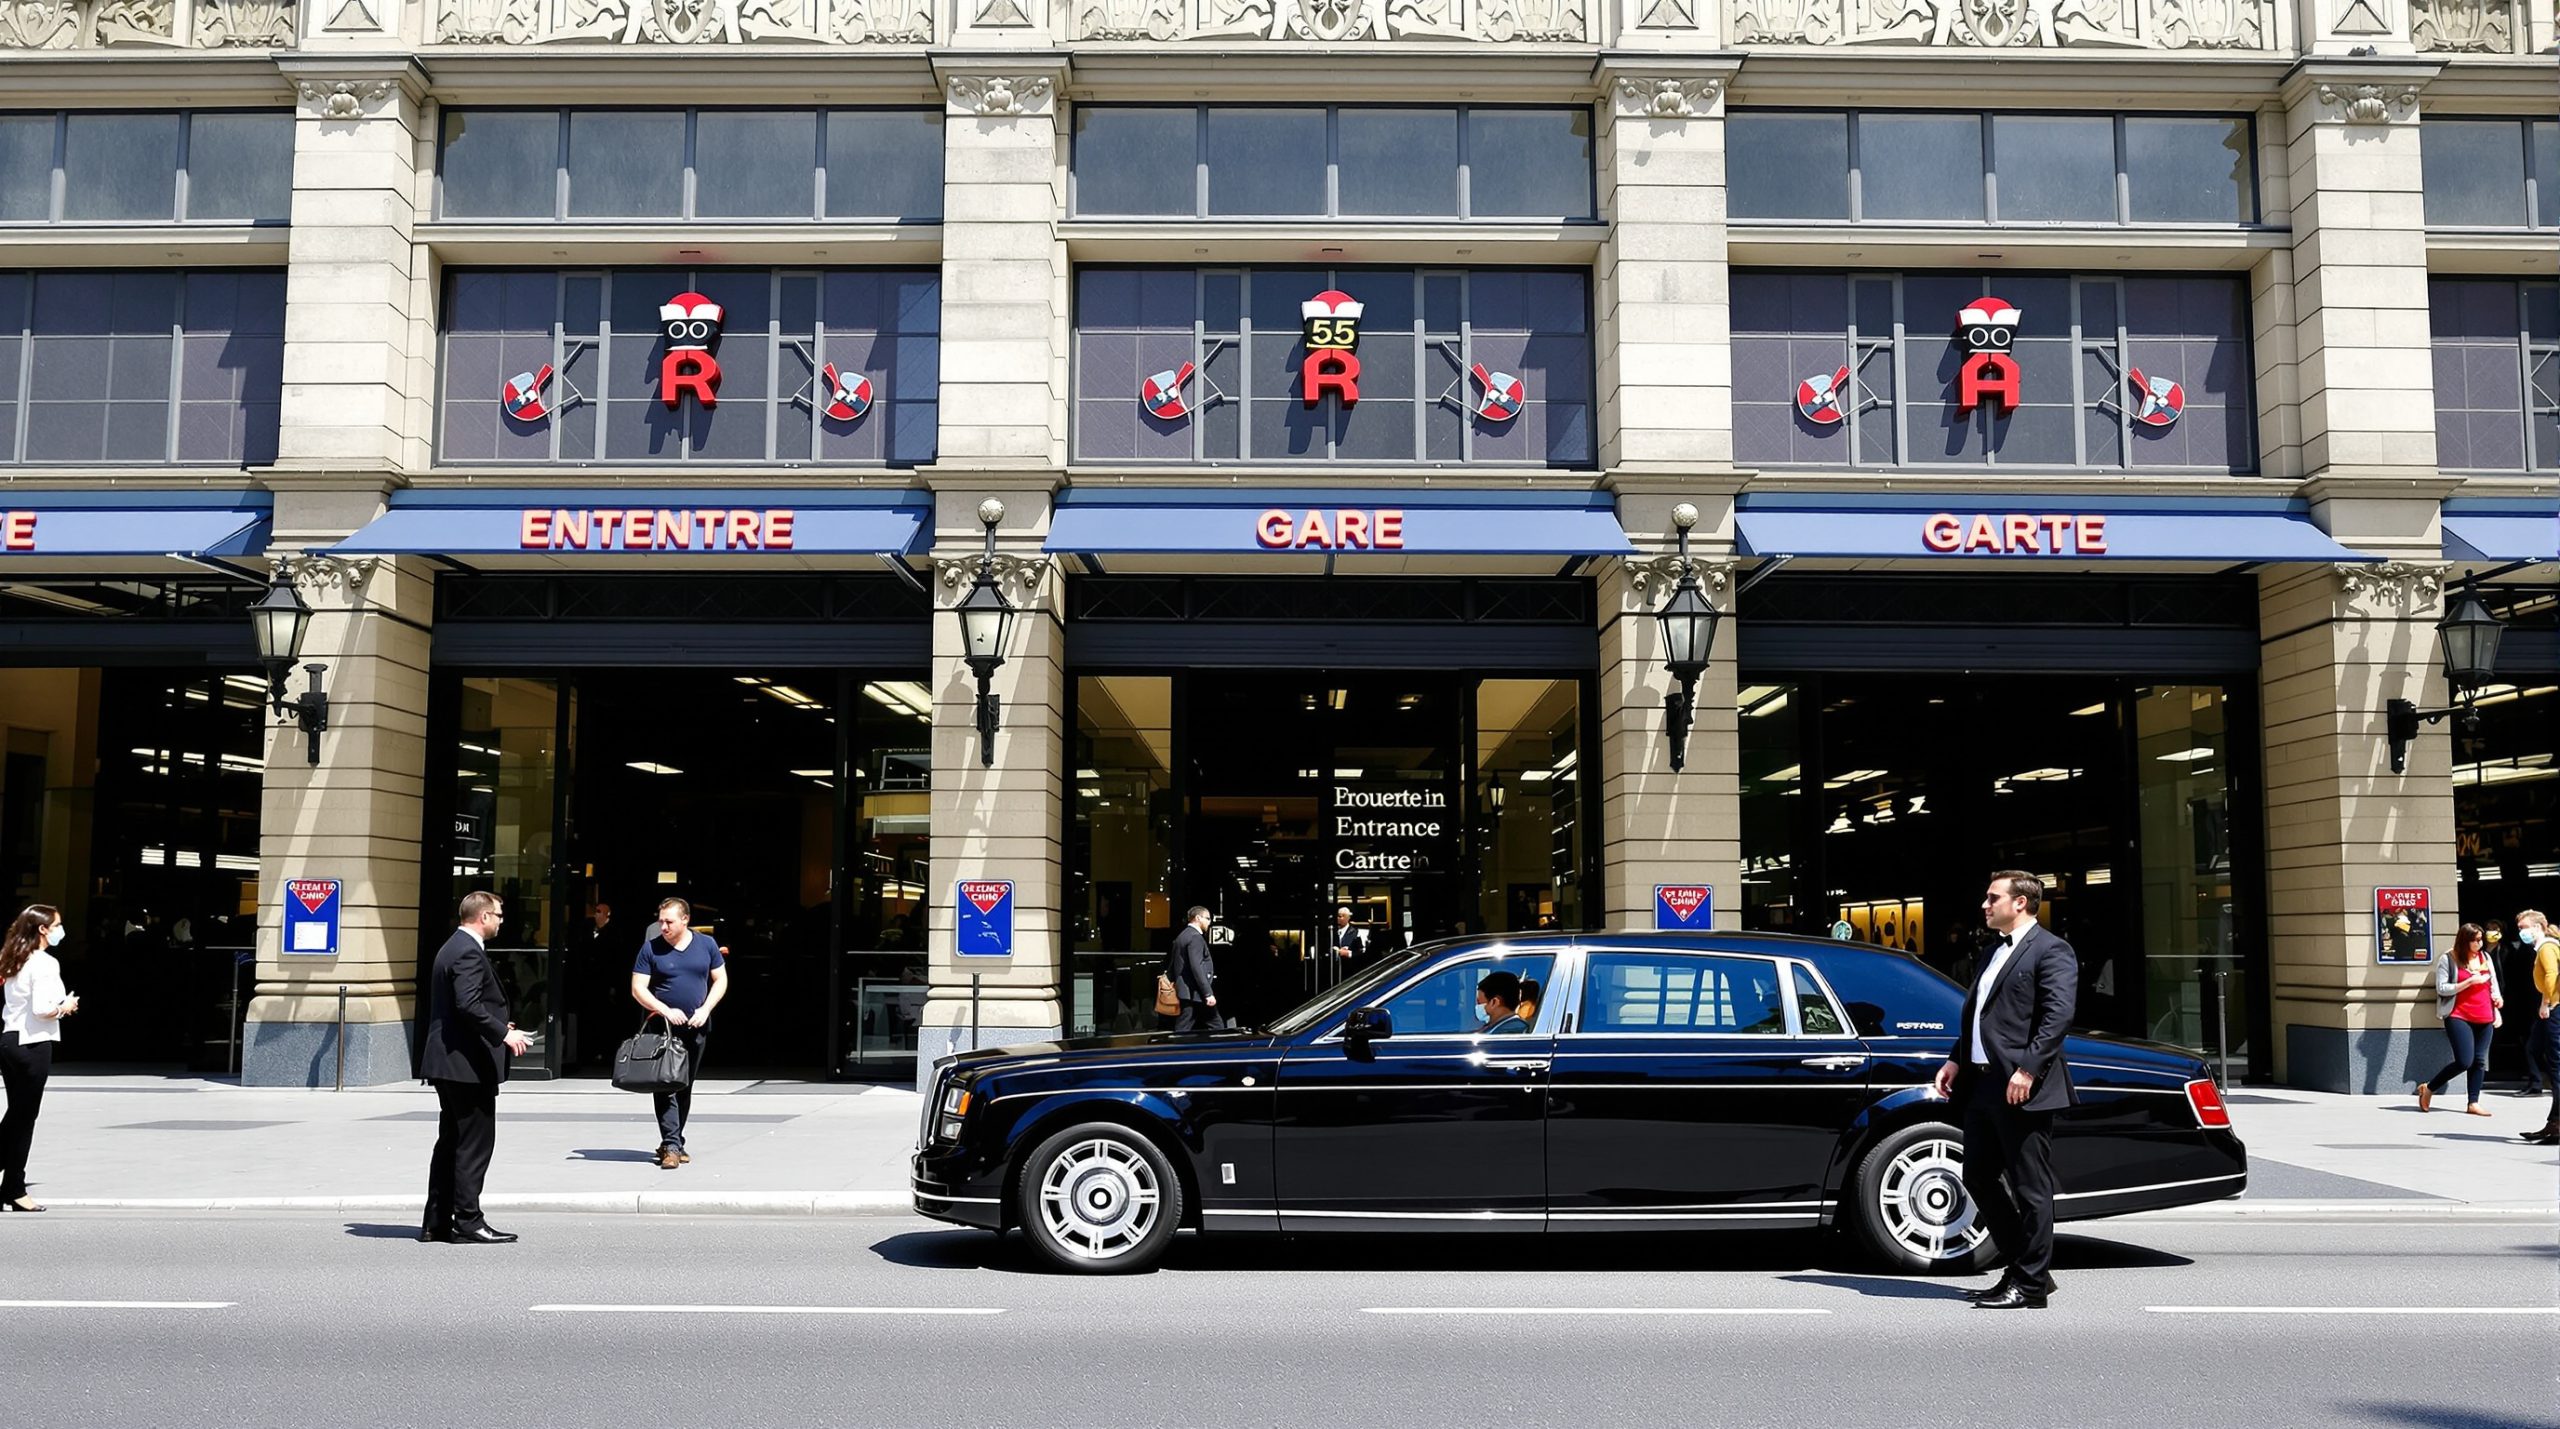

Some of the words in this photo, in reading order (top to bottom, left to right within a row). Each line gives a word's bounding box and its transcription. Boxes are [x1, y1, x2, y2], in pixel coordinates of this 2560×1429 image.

[1312, 319, 1355, 345] 55
[661, 349, 720, 406] R
[1303, 348, 1360, 406] R
[0, 511, 37, 551] E
[520, 509, 794, 550] ENTENTRE
[1256, 508, 1404, 550] GARE
[1922, 513, 2108, 555] GARTE
[1335, 816, 1440, 837] Entrance
